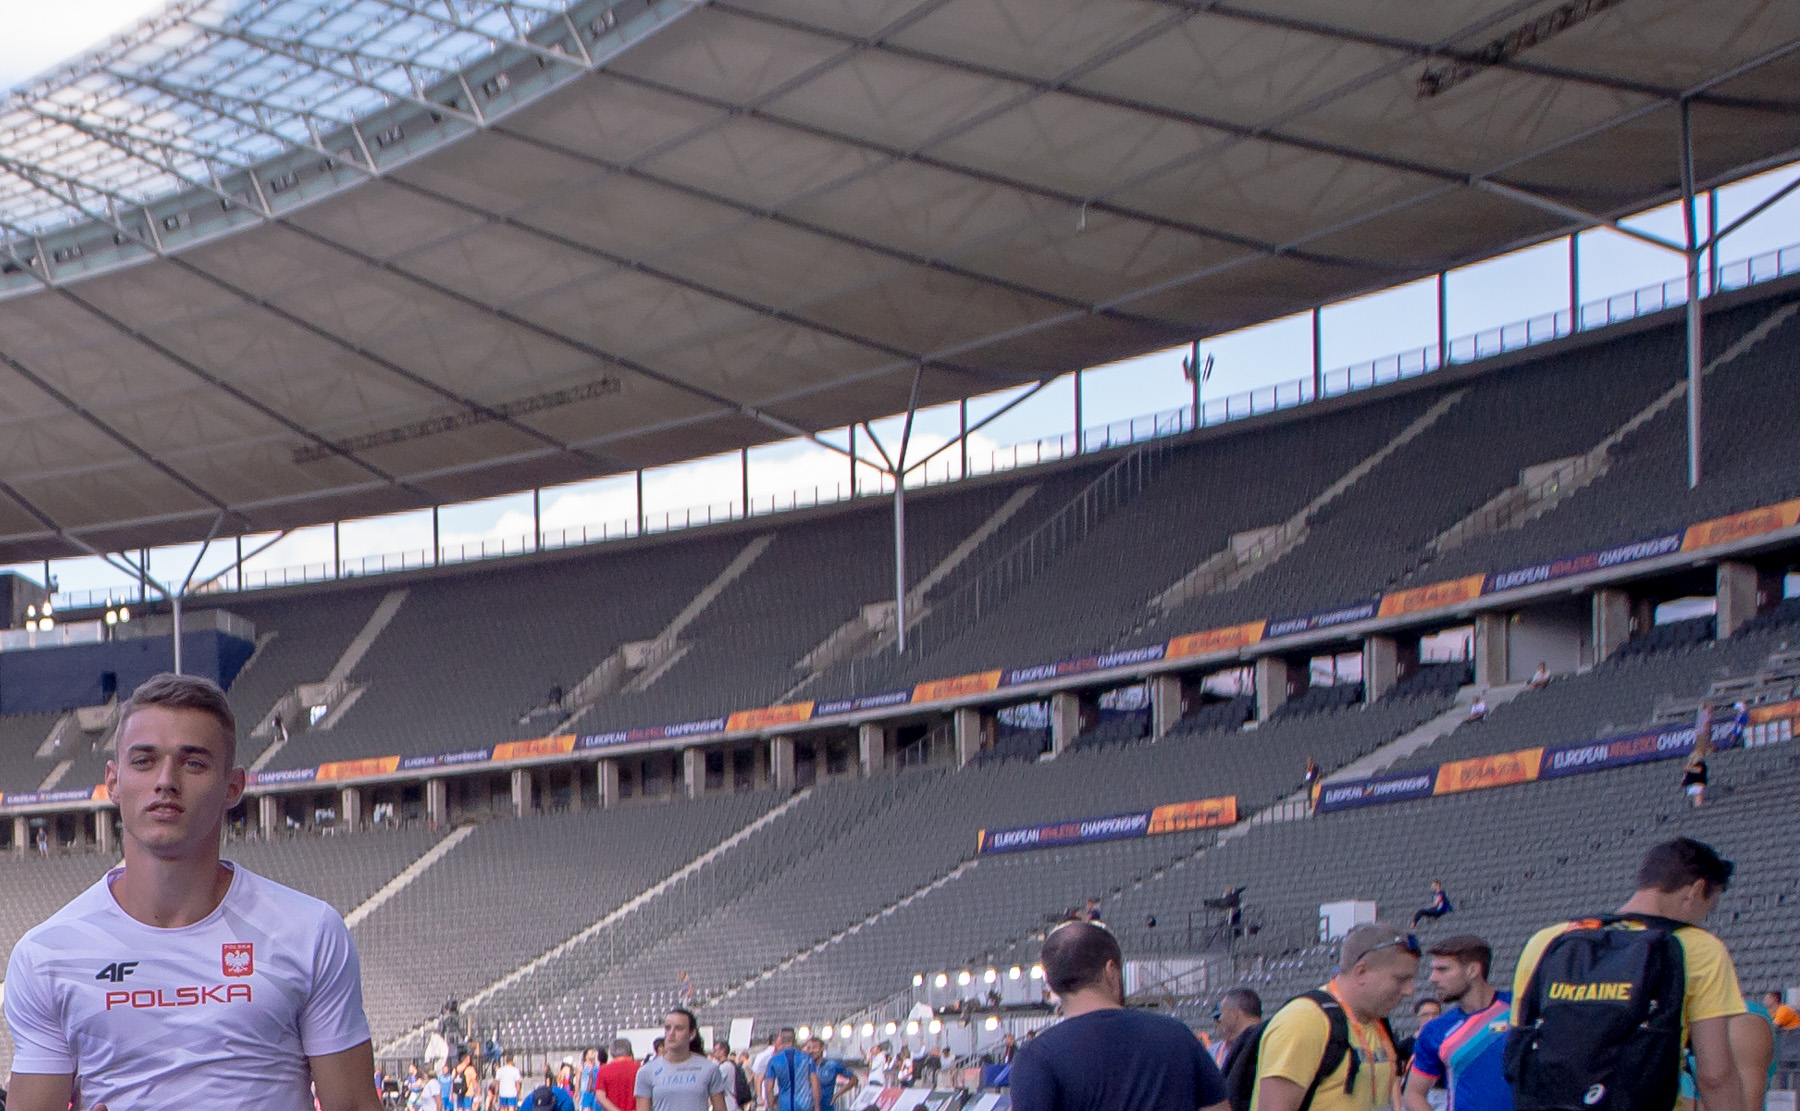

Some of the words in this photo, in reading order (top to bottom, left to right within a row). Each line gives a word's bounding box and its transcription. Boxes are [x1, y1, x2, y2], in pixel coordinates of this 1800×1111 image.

[1554, 745, 1608, 769] EUROPEAN
[95, 961, 139, 982] 4F
[106, 983, 252, 1010] POLSKA
[1550, 982, 1633, 1001] UKRAINE
[663, 1073, 697, 1085] ITALIA
